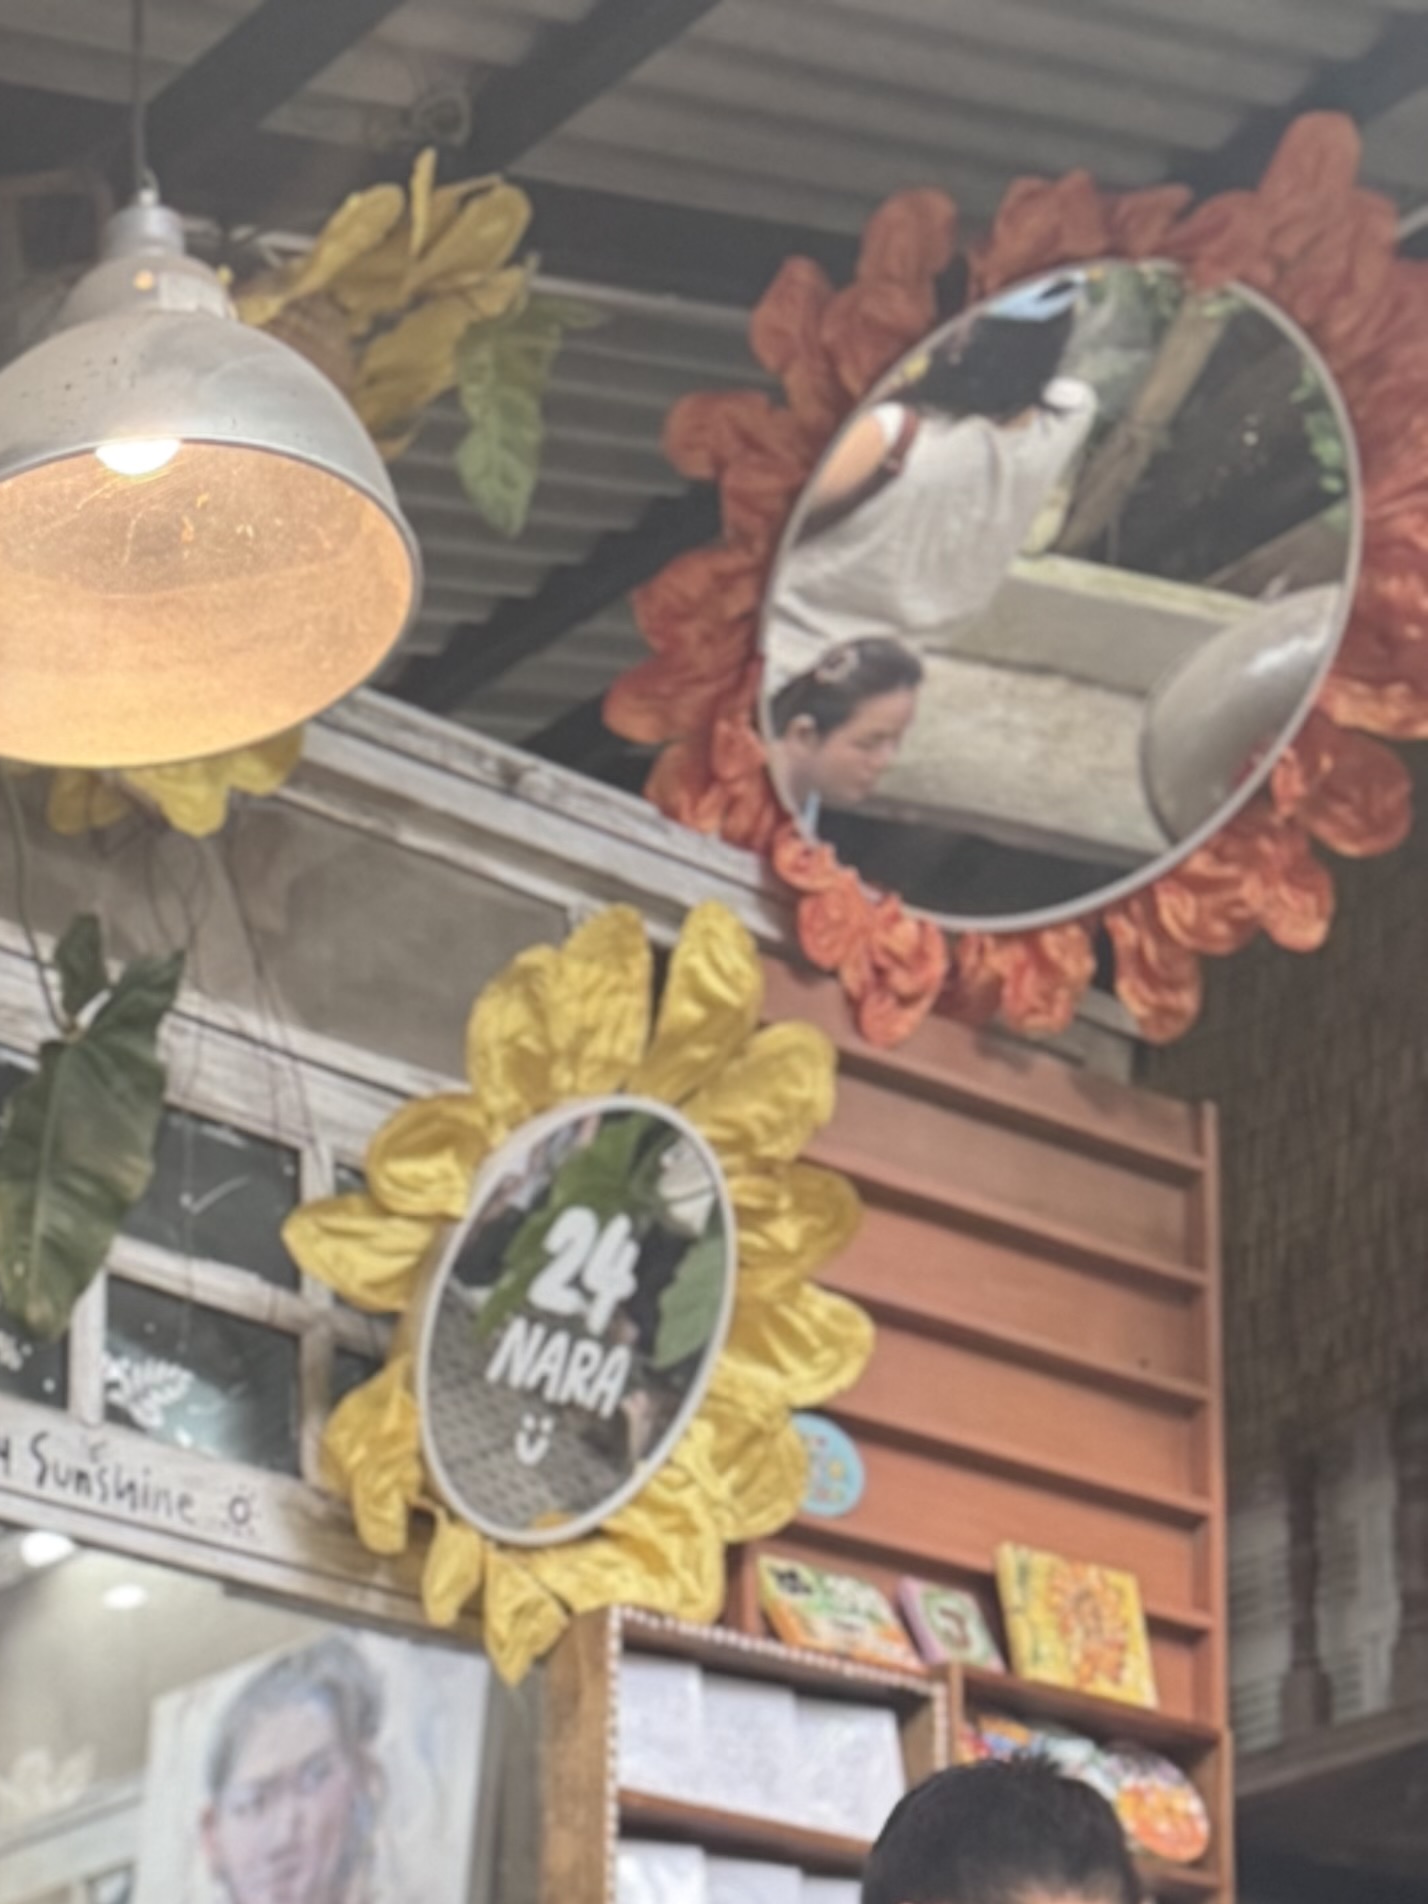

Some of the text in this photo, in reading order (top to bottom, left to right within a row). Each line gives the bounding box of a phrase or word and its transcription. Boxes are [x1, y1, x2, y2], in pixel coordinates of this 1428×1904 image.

[528, 1205, 640, 1335] 24
[485, 1315, 633, 1420] NARA
[30, 1433, 198, 1523] Sunshine
